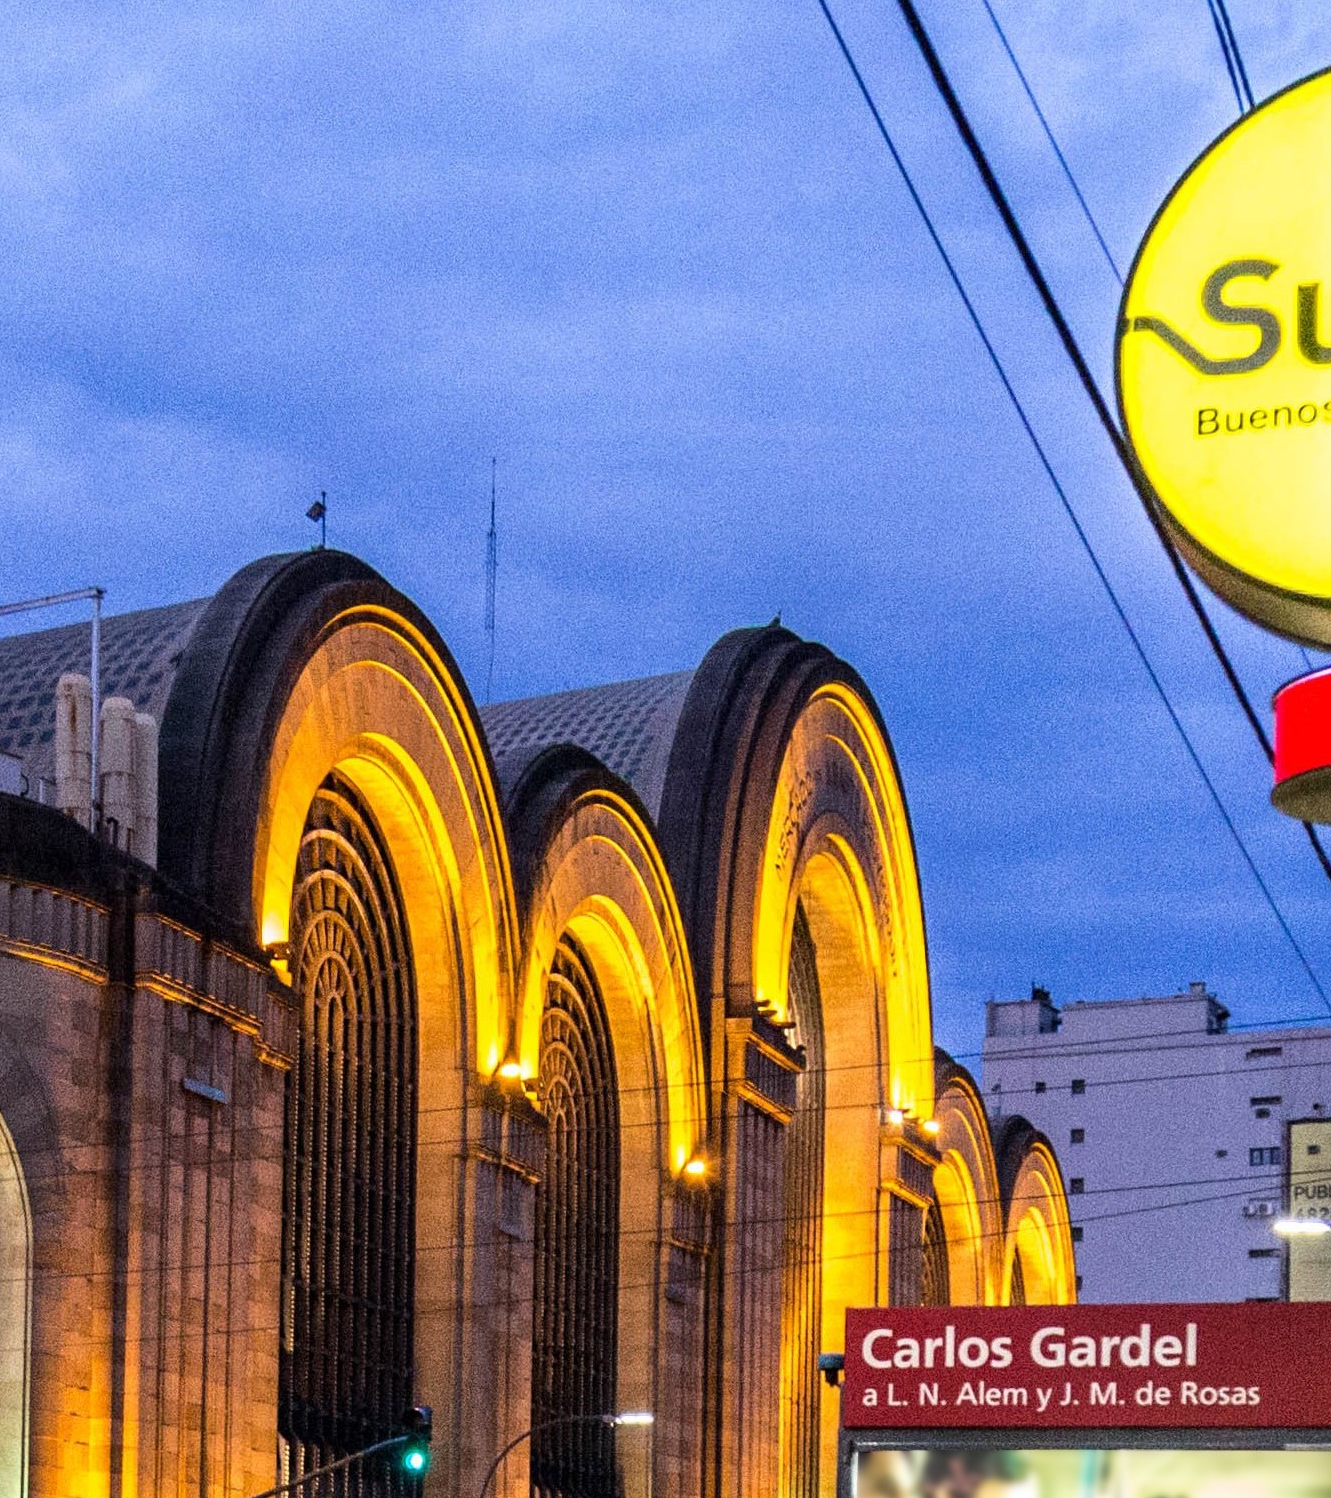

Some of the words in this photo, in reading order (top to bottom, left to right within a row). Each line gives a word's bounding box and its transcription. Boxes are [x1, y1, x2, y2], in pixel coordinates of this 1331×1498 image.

[860, 1325, 1013, 1370] Carlos
[1029, 1322, 1198, 1369] Gardel
[861, 1387, 879, 1407] a
[887, 1382, 909, 1407] L.
[918, 1382, 948, 1407] N.
[955, 1380, 1029, 1407] Alem
[1035, 1387, 1054, 1413] y
[1058, 1382, 1079, 1408] J.
[1089, 1381, 1126, 1407] M.
[1134, 1380, 1172, 1407] de
[1180, 1380, 1262, 1407] Rosas
